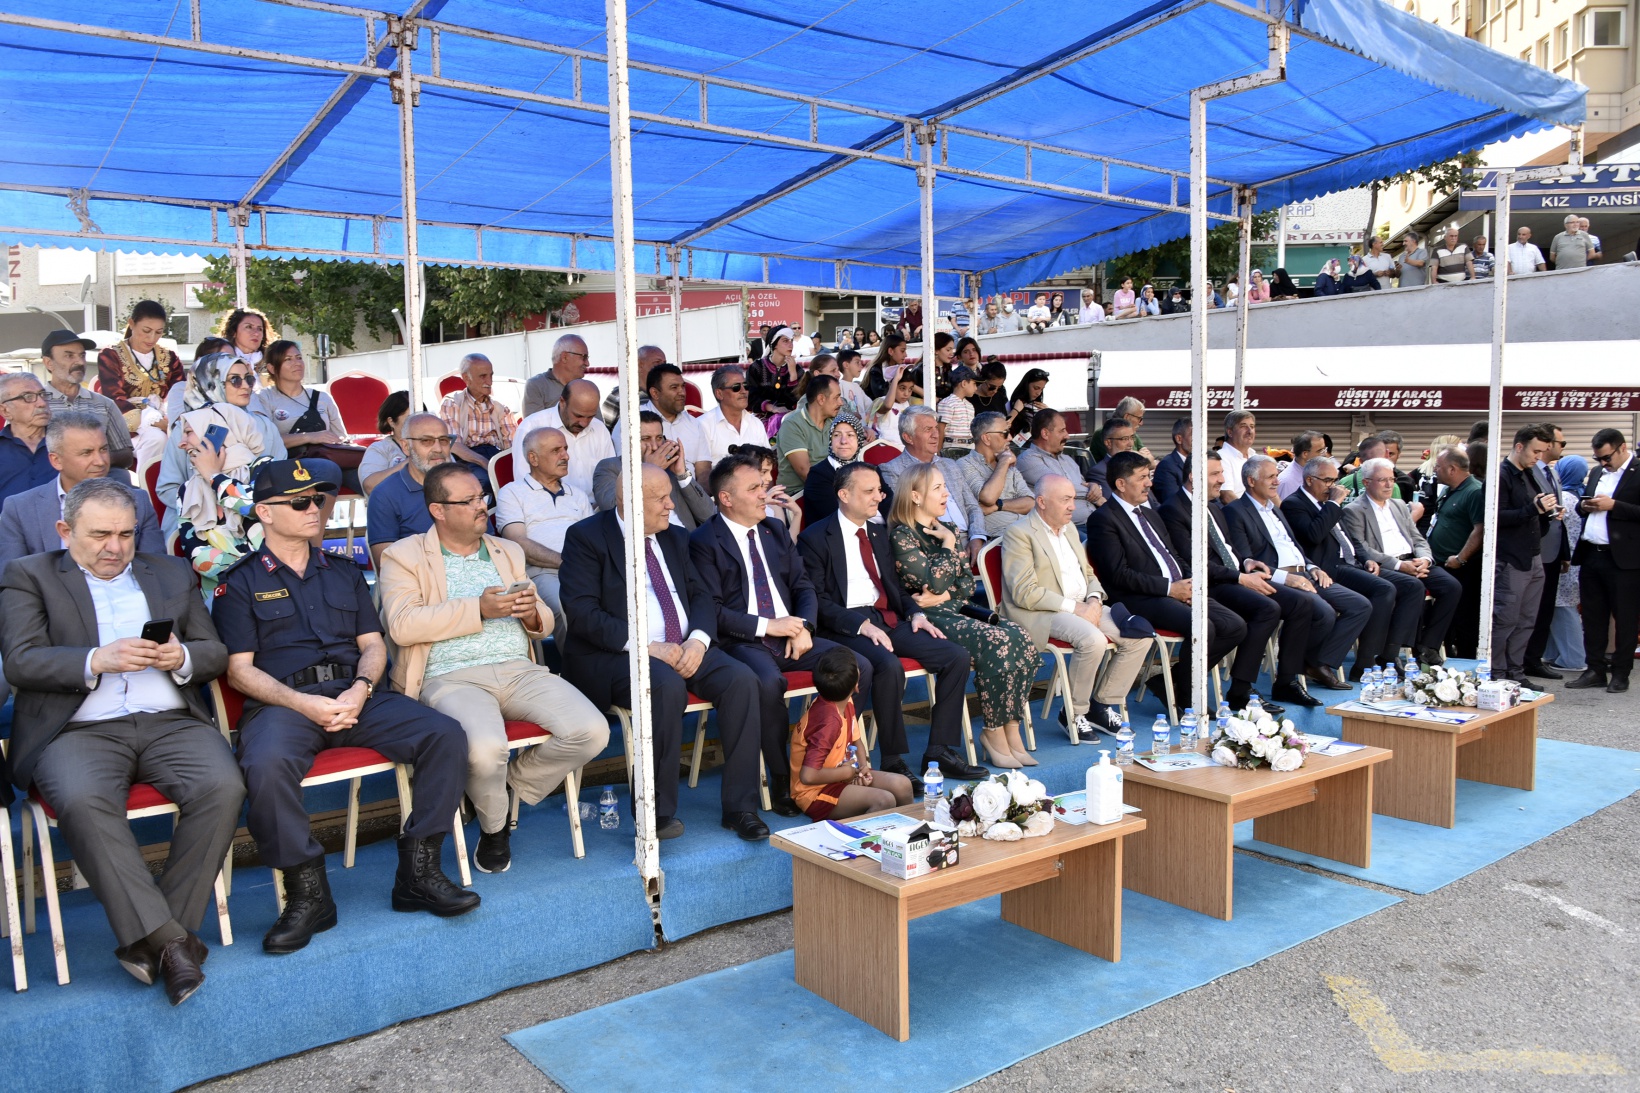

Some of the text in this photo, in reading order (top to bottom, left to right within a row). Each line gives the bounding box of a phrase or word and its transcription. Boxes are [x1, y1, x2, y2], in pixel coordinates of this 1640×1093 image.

[1541, 192, 1640, 207] KIZ PANSİ
[1392, 390, 1442, 399] KARACA
[1156, 399, 1189, 407] 0533
[1334, 399, 1443, 408] 0537 727 09 38
